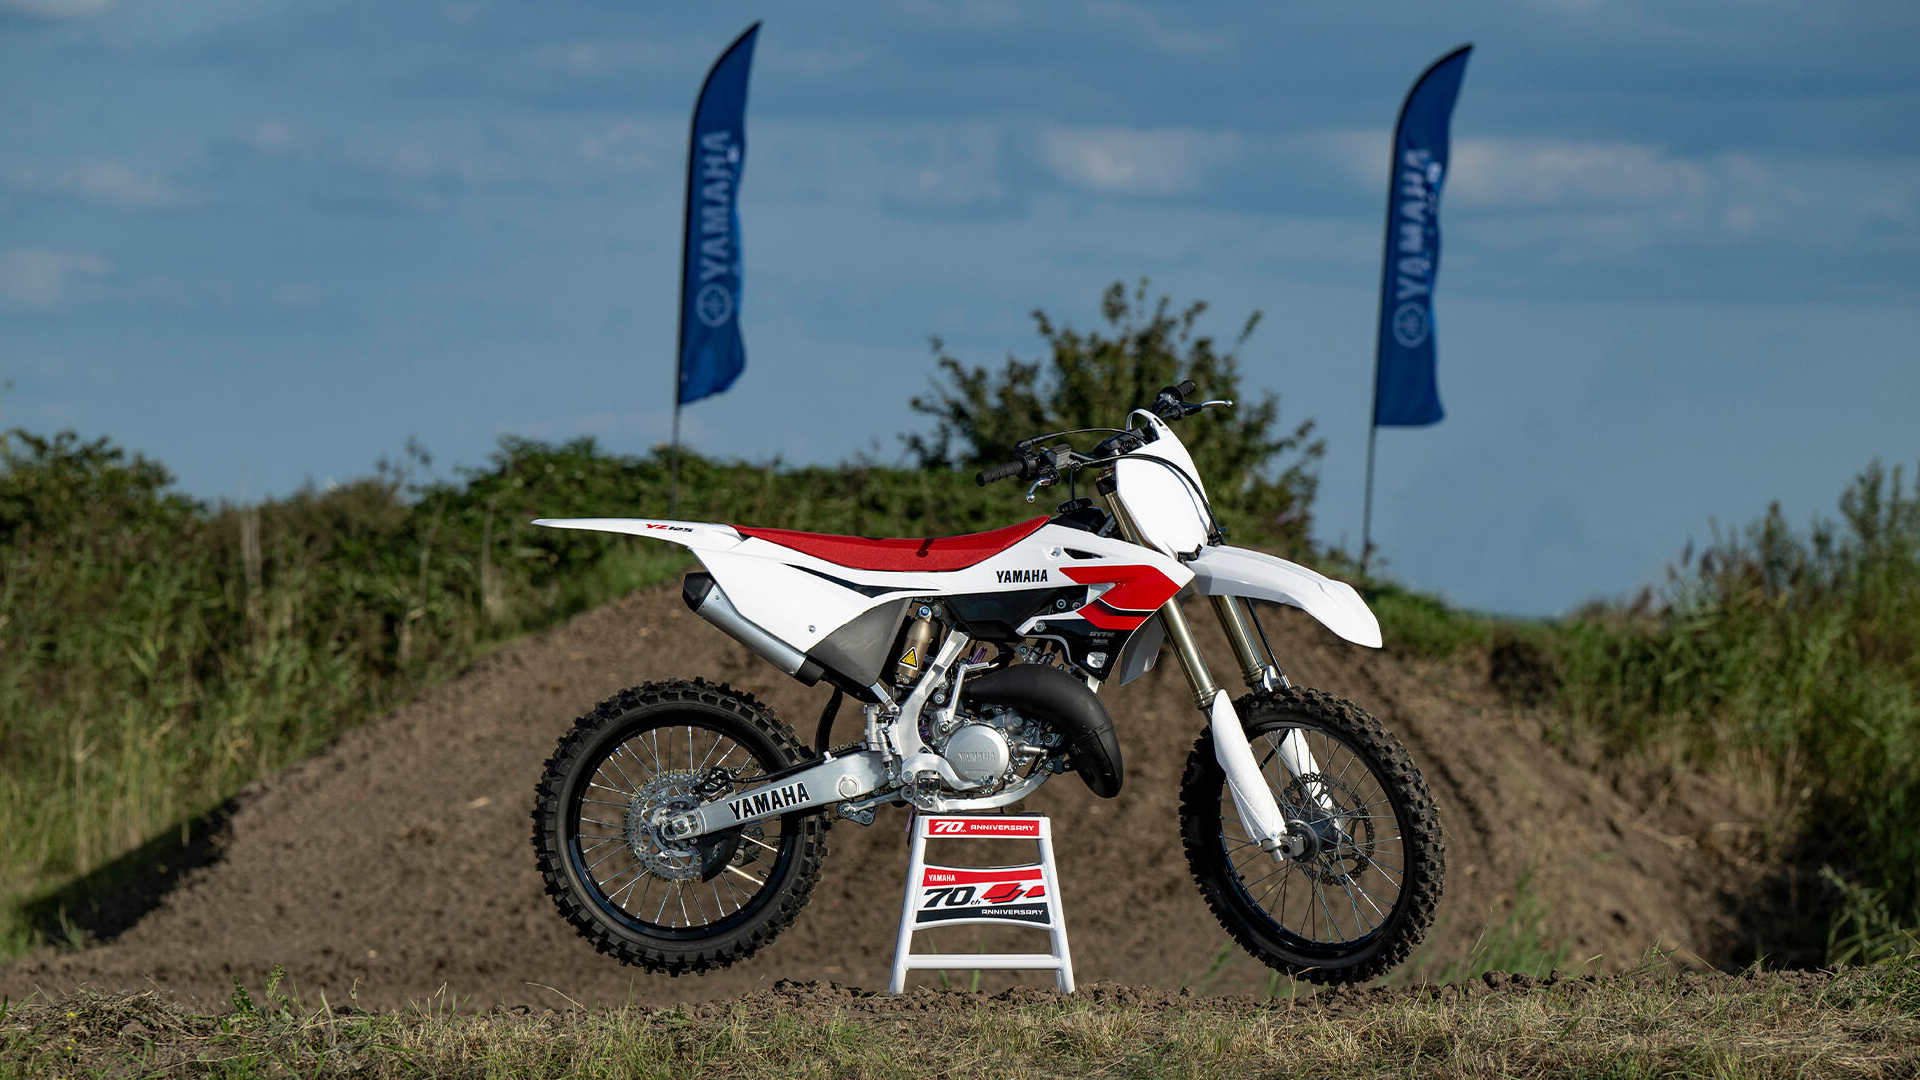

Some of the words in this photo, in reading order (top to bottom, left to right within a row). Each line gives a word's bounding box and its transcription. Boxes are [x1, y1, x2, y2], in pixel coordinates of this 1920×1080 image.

[701, 131, 731, 281] YAMAHA
[1397, 149, 1430, 299] YAMAHA
[646, 523, 694, 532] YZ125
[996, 569, 1048, 583] YAMAHA
[958, 752, 996, 762] YAMAHA
[728, 782, 811, 820] YAMAHA
[928, 874, 956, 882] YAMAHA
